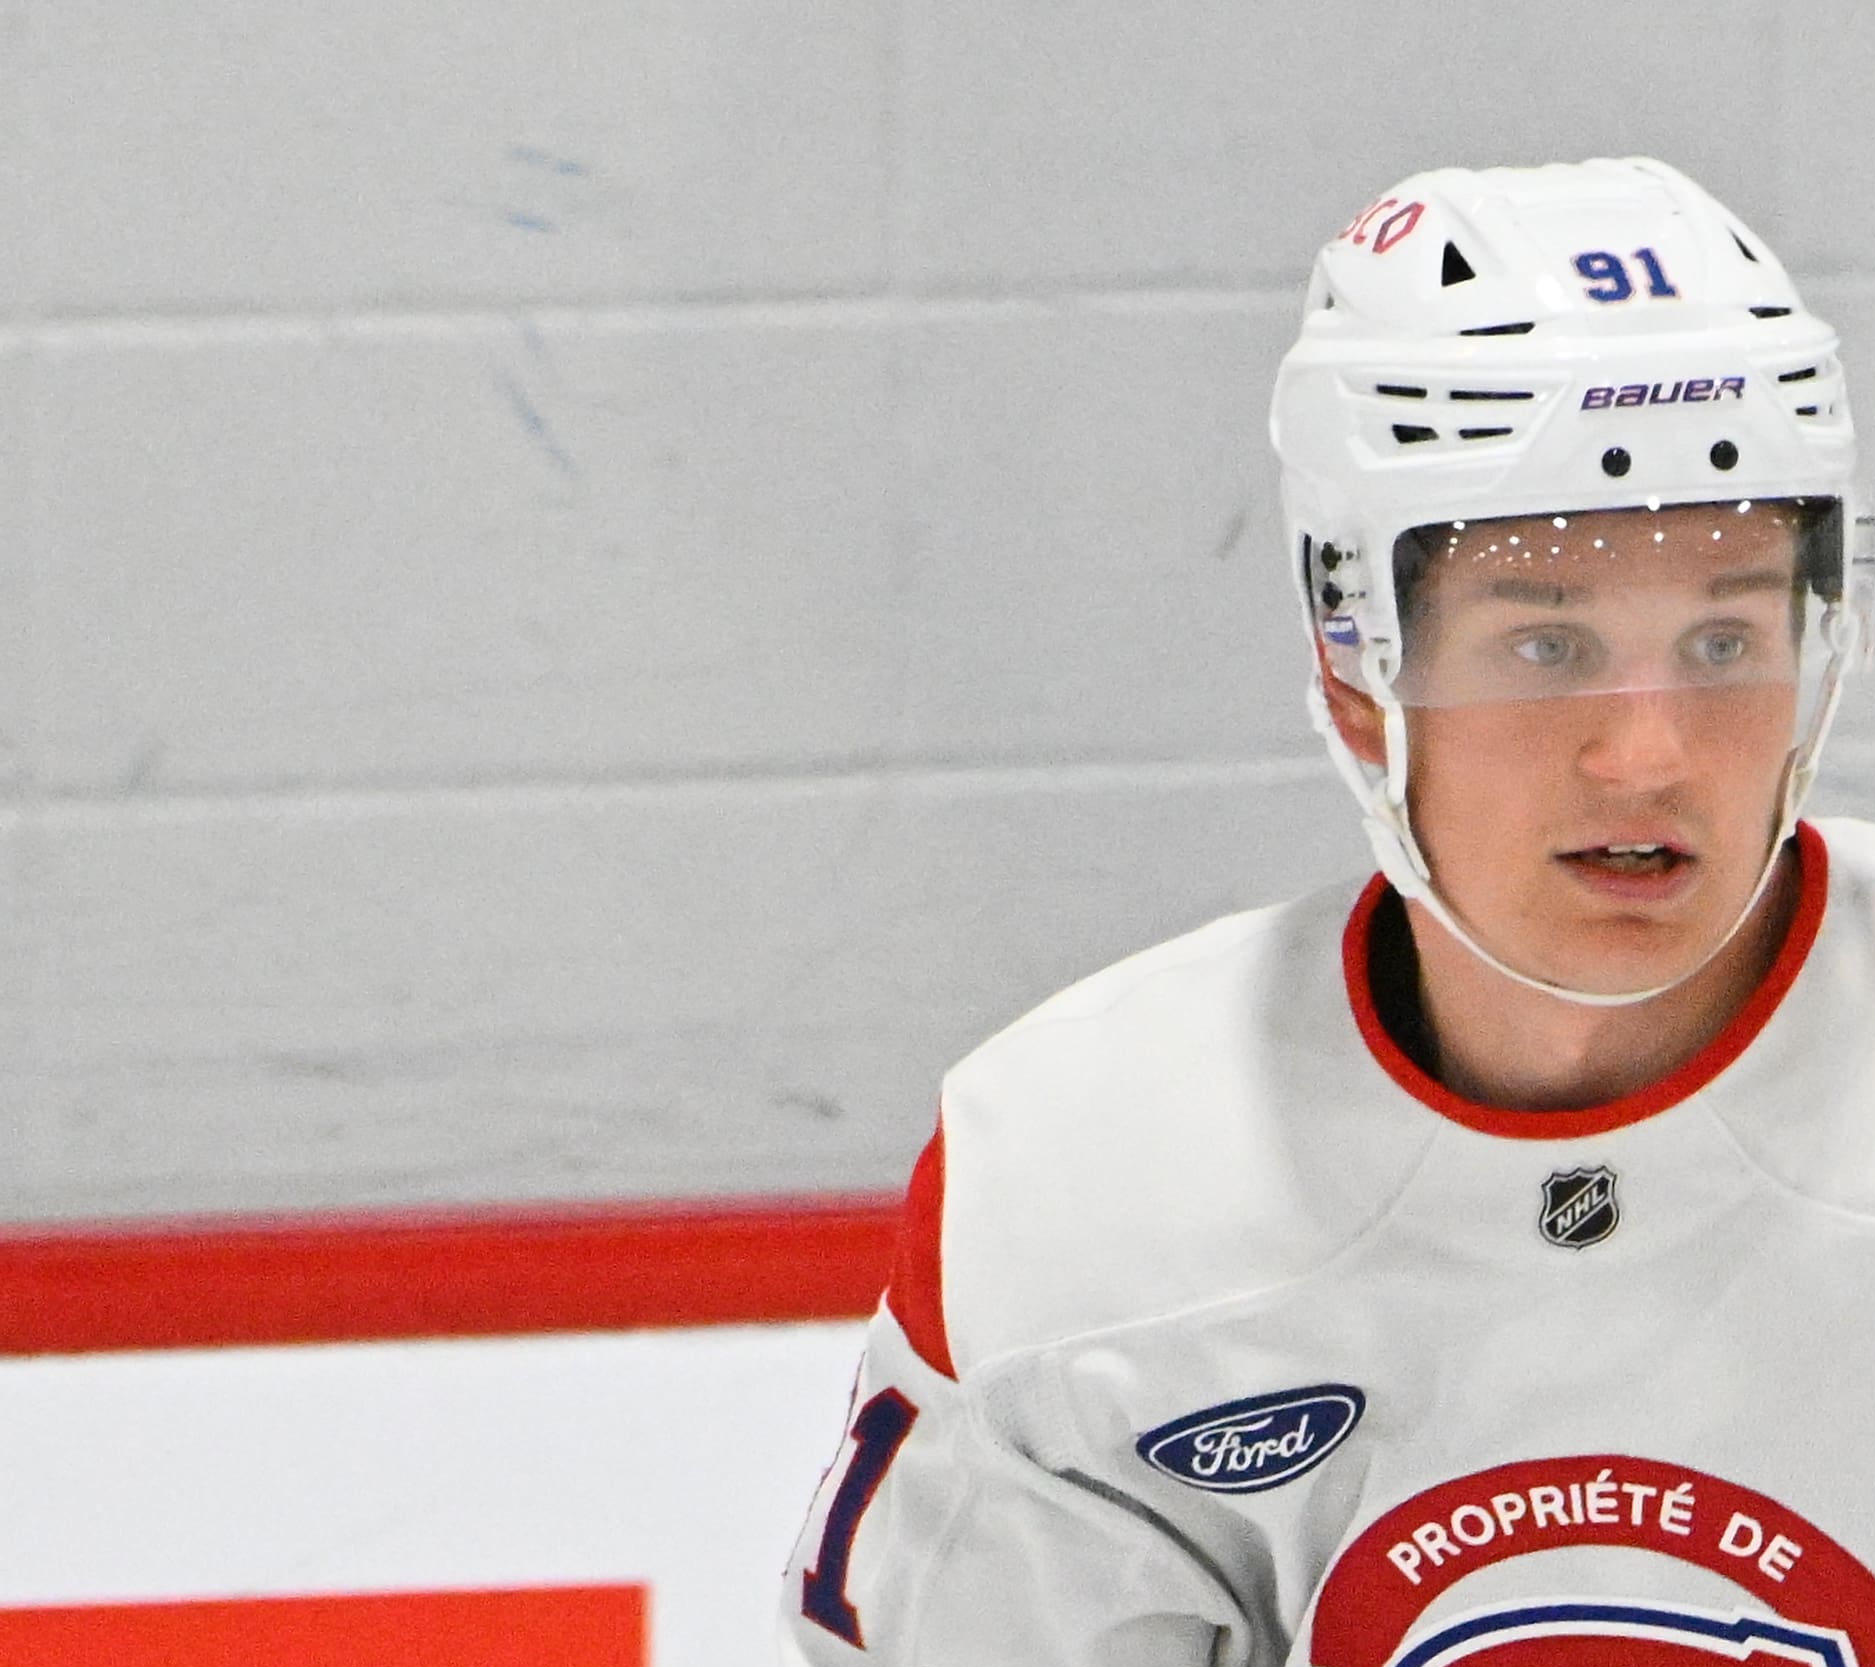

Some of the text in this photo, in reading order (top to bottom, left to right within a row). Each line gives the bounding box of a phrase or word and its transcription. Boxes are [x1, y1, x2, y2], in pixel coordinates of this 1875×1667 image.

[1572, 247, 1681, 301] 91
[1580, 376, 1746, 411] BAUER
[1556, 1184, 1606, 1235] NHL
[1191, 1413, 1313, 1475] Ford
[1387, 1468, 1803, 1586] PROPRIÉTÉ DE
